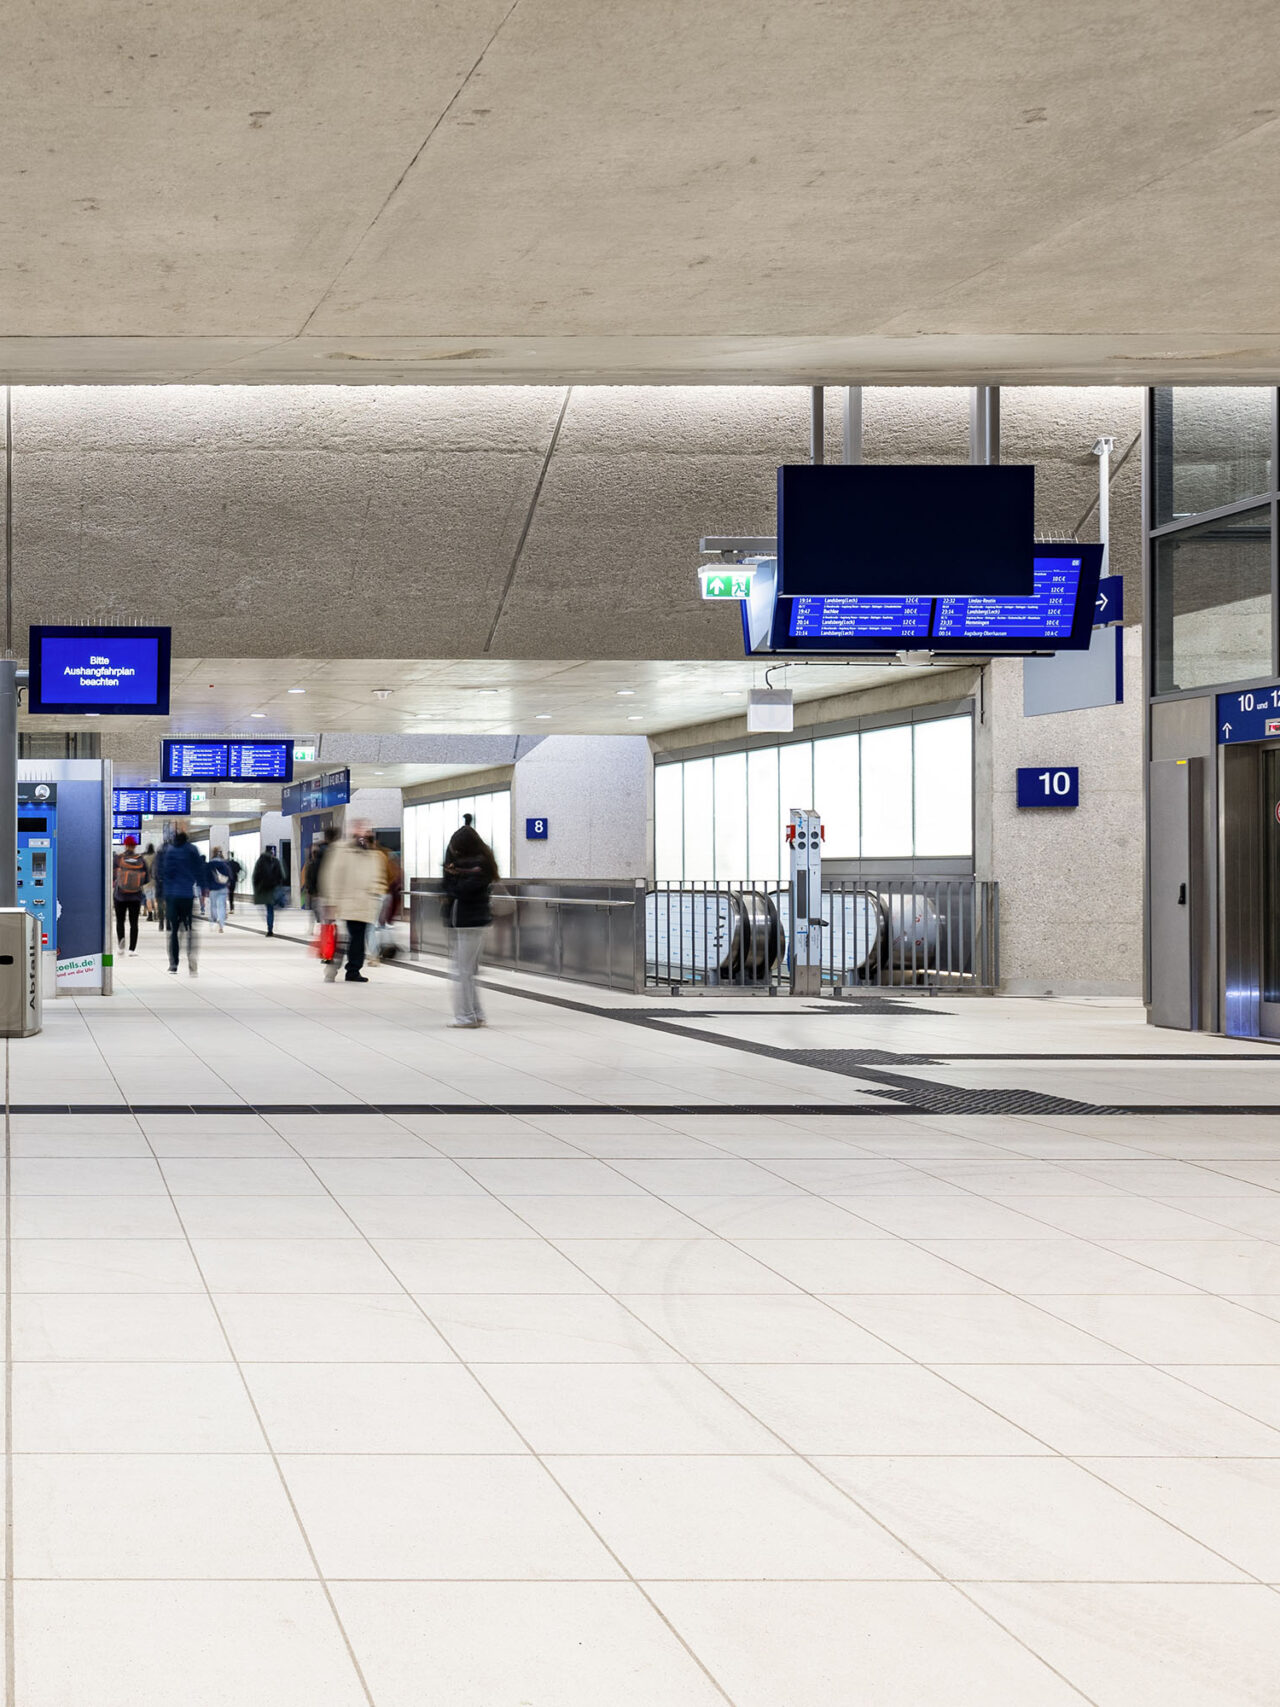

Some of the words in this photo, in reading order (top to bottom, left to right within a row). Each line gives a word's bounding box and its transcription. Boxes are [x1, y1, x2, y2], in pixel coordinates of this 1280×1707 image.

[90, 656, 110, 665] Bitte
[64, 667, 135, 676] Aushangfahrplan
[80, 677, 119, 686] beachten
[1238, 693, 1254, 712] 10
[1271, 690, 1280, 708] 1
[1038, 771, 1070, 795] 10
[534, 820, 543, 833] 8
